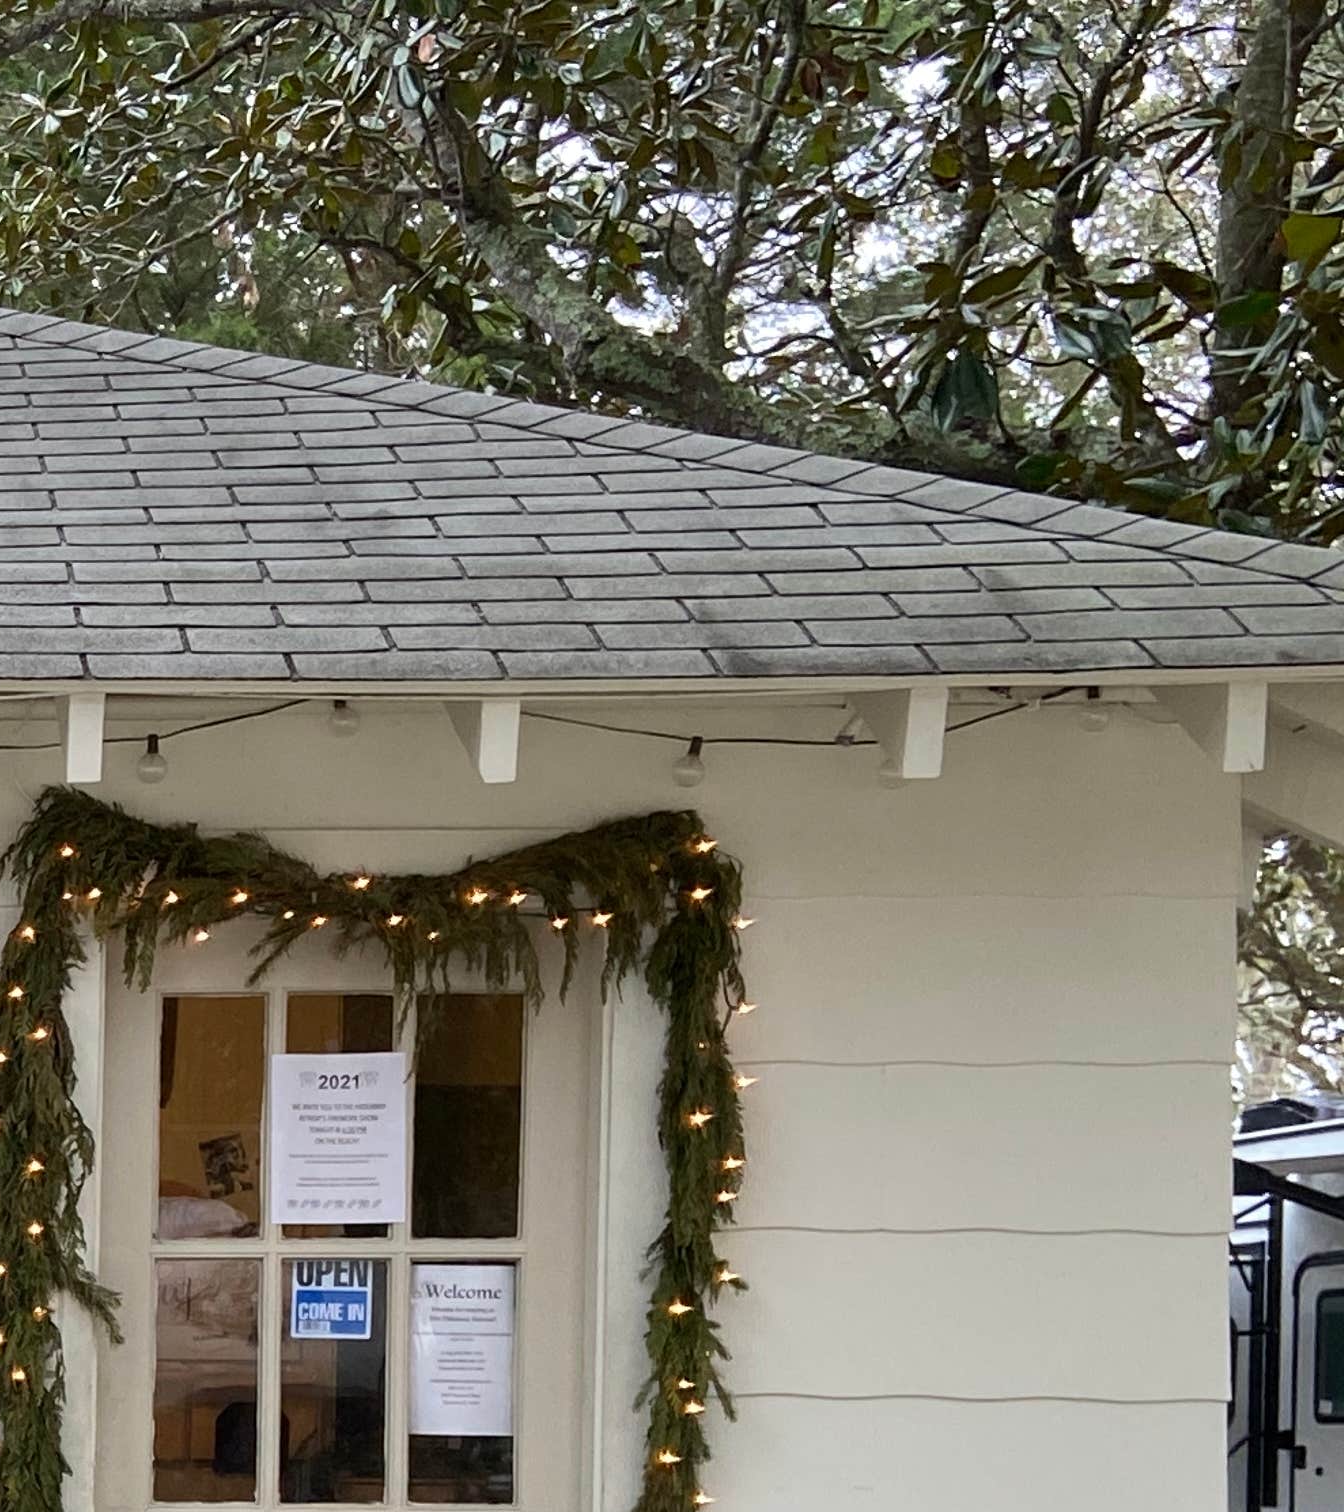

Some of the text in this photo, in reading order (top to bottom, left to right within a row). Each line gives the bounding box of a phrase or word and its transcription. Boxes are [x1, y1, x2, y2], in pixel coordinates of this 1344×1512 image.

[318, 1074, 360, 1090] 2021
[296, 1260, 368, 1287] OPEN
[425, 1283, 503, 1300] Welcome
[298, 1302, 365, 1321] COME IN
